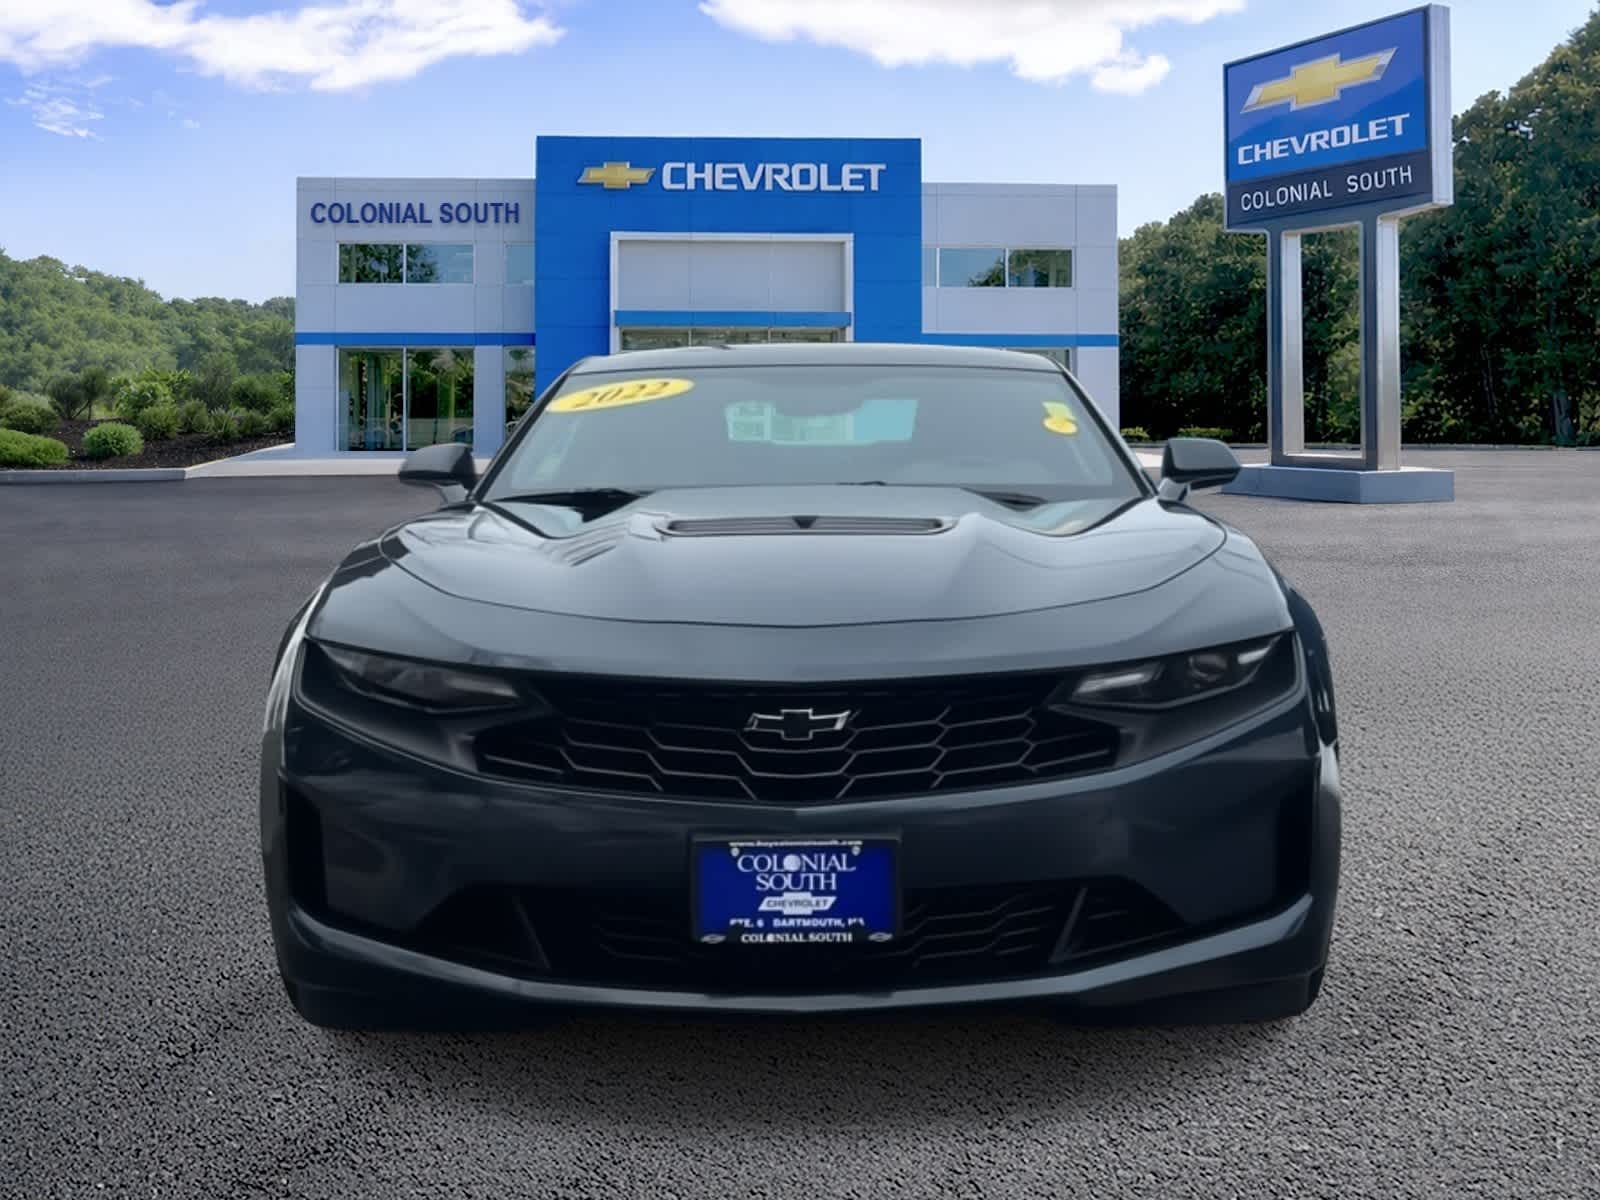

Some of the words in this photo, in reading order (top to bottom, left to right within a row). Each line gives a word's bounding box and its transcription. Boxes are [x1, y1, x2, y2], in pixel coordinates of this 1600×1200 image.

[1237, 113, 1410, 165] CHEVROLET
[662, 162, 887, 192] CHEVROLET
[1240, 180, 1333, 211] COLONIAL
[1346, 165, 1413, 193] SOUTH
[310, 202, 433, 224] COLONIAL
[439, 202, 520, 224] SOUTH
[571, 381, 671, 408] 2022
[737, 853, 857, 872] COLONIAL
[756, 873, 837, 891] SOUTH
[808, 932, 854, 943] SOUTH
